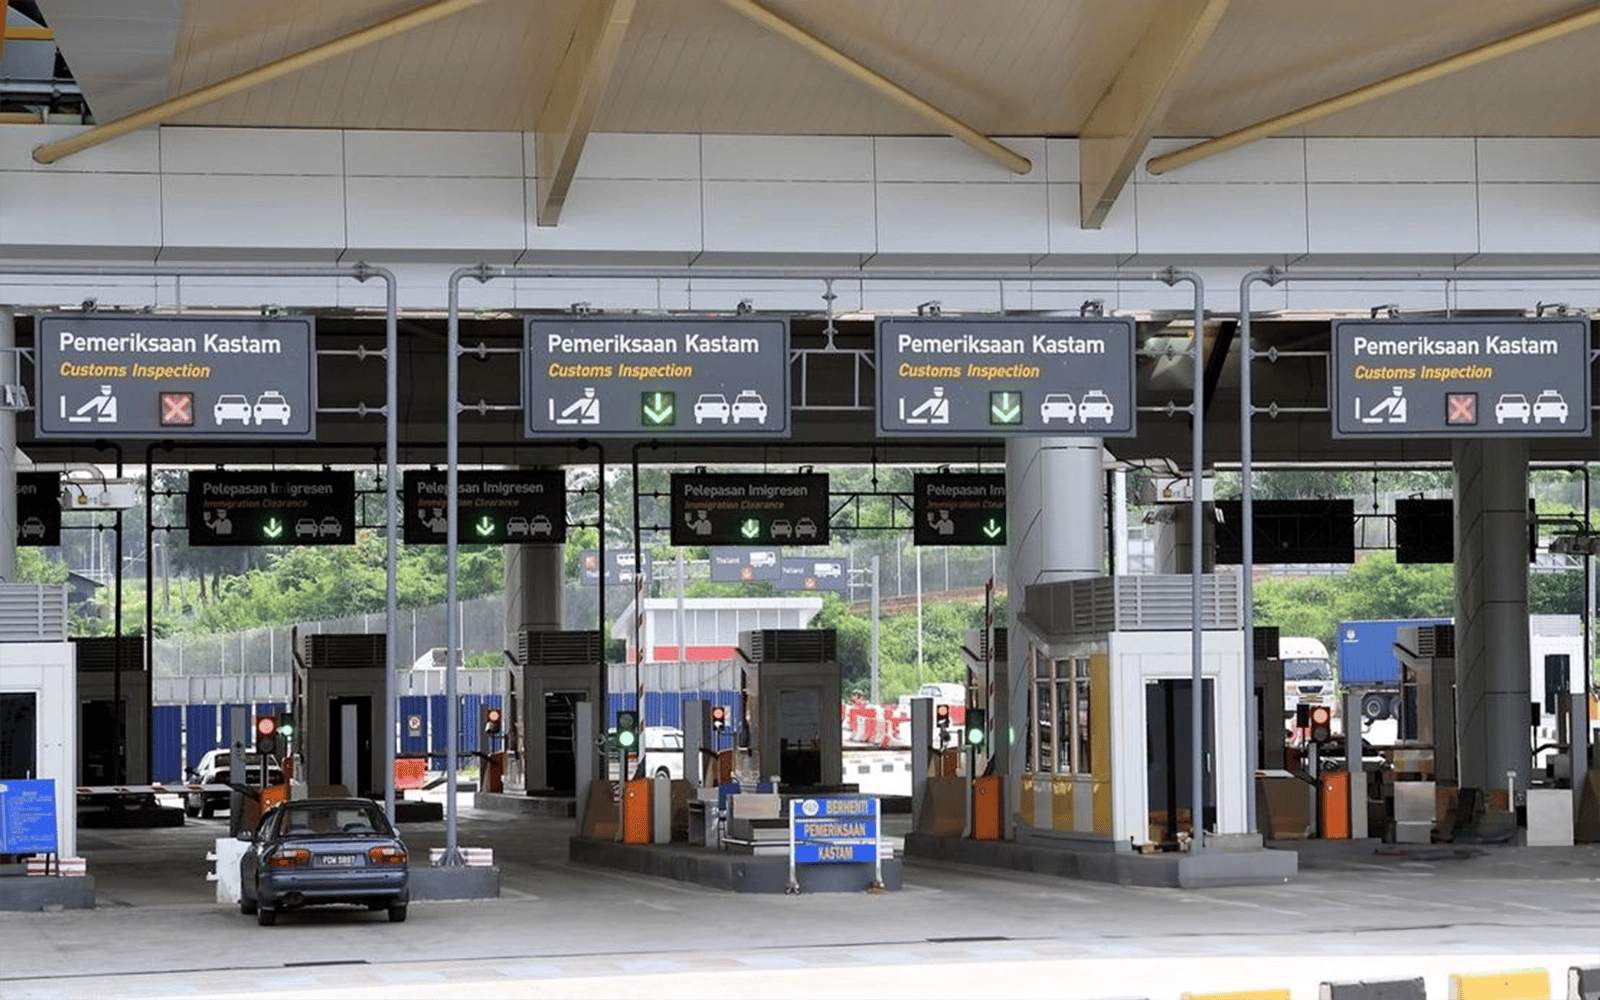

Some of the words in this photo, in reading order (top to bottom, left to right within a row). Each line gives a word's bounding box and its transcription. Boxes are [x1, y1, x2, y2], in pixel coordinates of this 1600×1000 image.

[59, 332, 197, 352] Pemeriksaan
[203, 333, 282, 353] Kastam
[548, 333, 677, 353] Pemeriksaan
[685, 333, 760, 353] Kastam
[898, 334, 1025, 353] Pemeriksaan
[1032, 334, 1105, 354] Kastam
[1353, 336, 1480, 355] Pemeriksaan
[1486, 336, 1558, 354] Kastam
[60, 362, 128, 378] Customs
[132, 363, 211, 380] Inspection
[548, 363, 613, 378] Customs
[618, 363, 693, 380] Inspection
[899, 363, 962, 378] Customs
[967, 363, 1040, 380] Inspection
[1354, 365, 1416, 380] Customs
[1420, 365, 1493, 382] Inspection
[203, 482, 267, 497] Pelepasan
[483, 481, 544, 496] Imigresen
[684, 483, 745, 498] Pelepasan
[749, 484, 808, 498] Imigresen
[926, 483, 987, 498] Pelepasan
[826, 799, 868, 815] BERHENTI
[804, 823, 866, 837] PEMERIKSAAN
[818, 845, 854, 860] KASTAM
